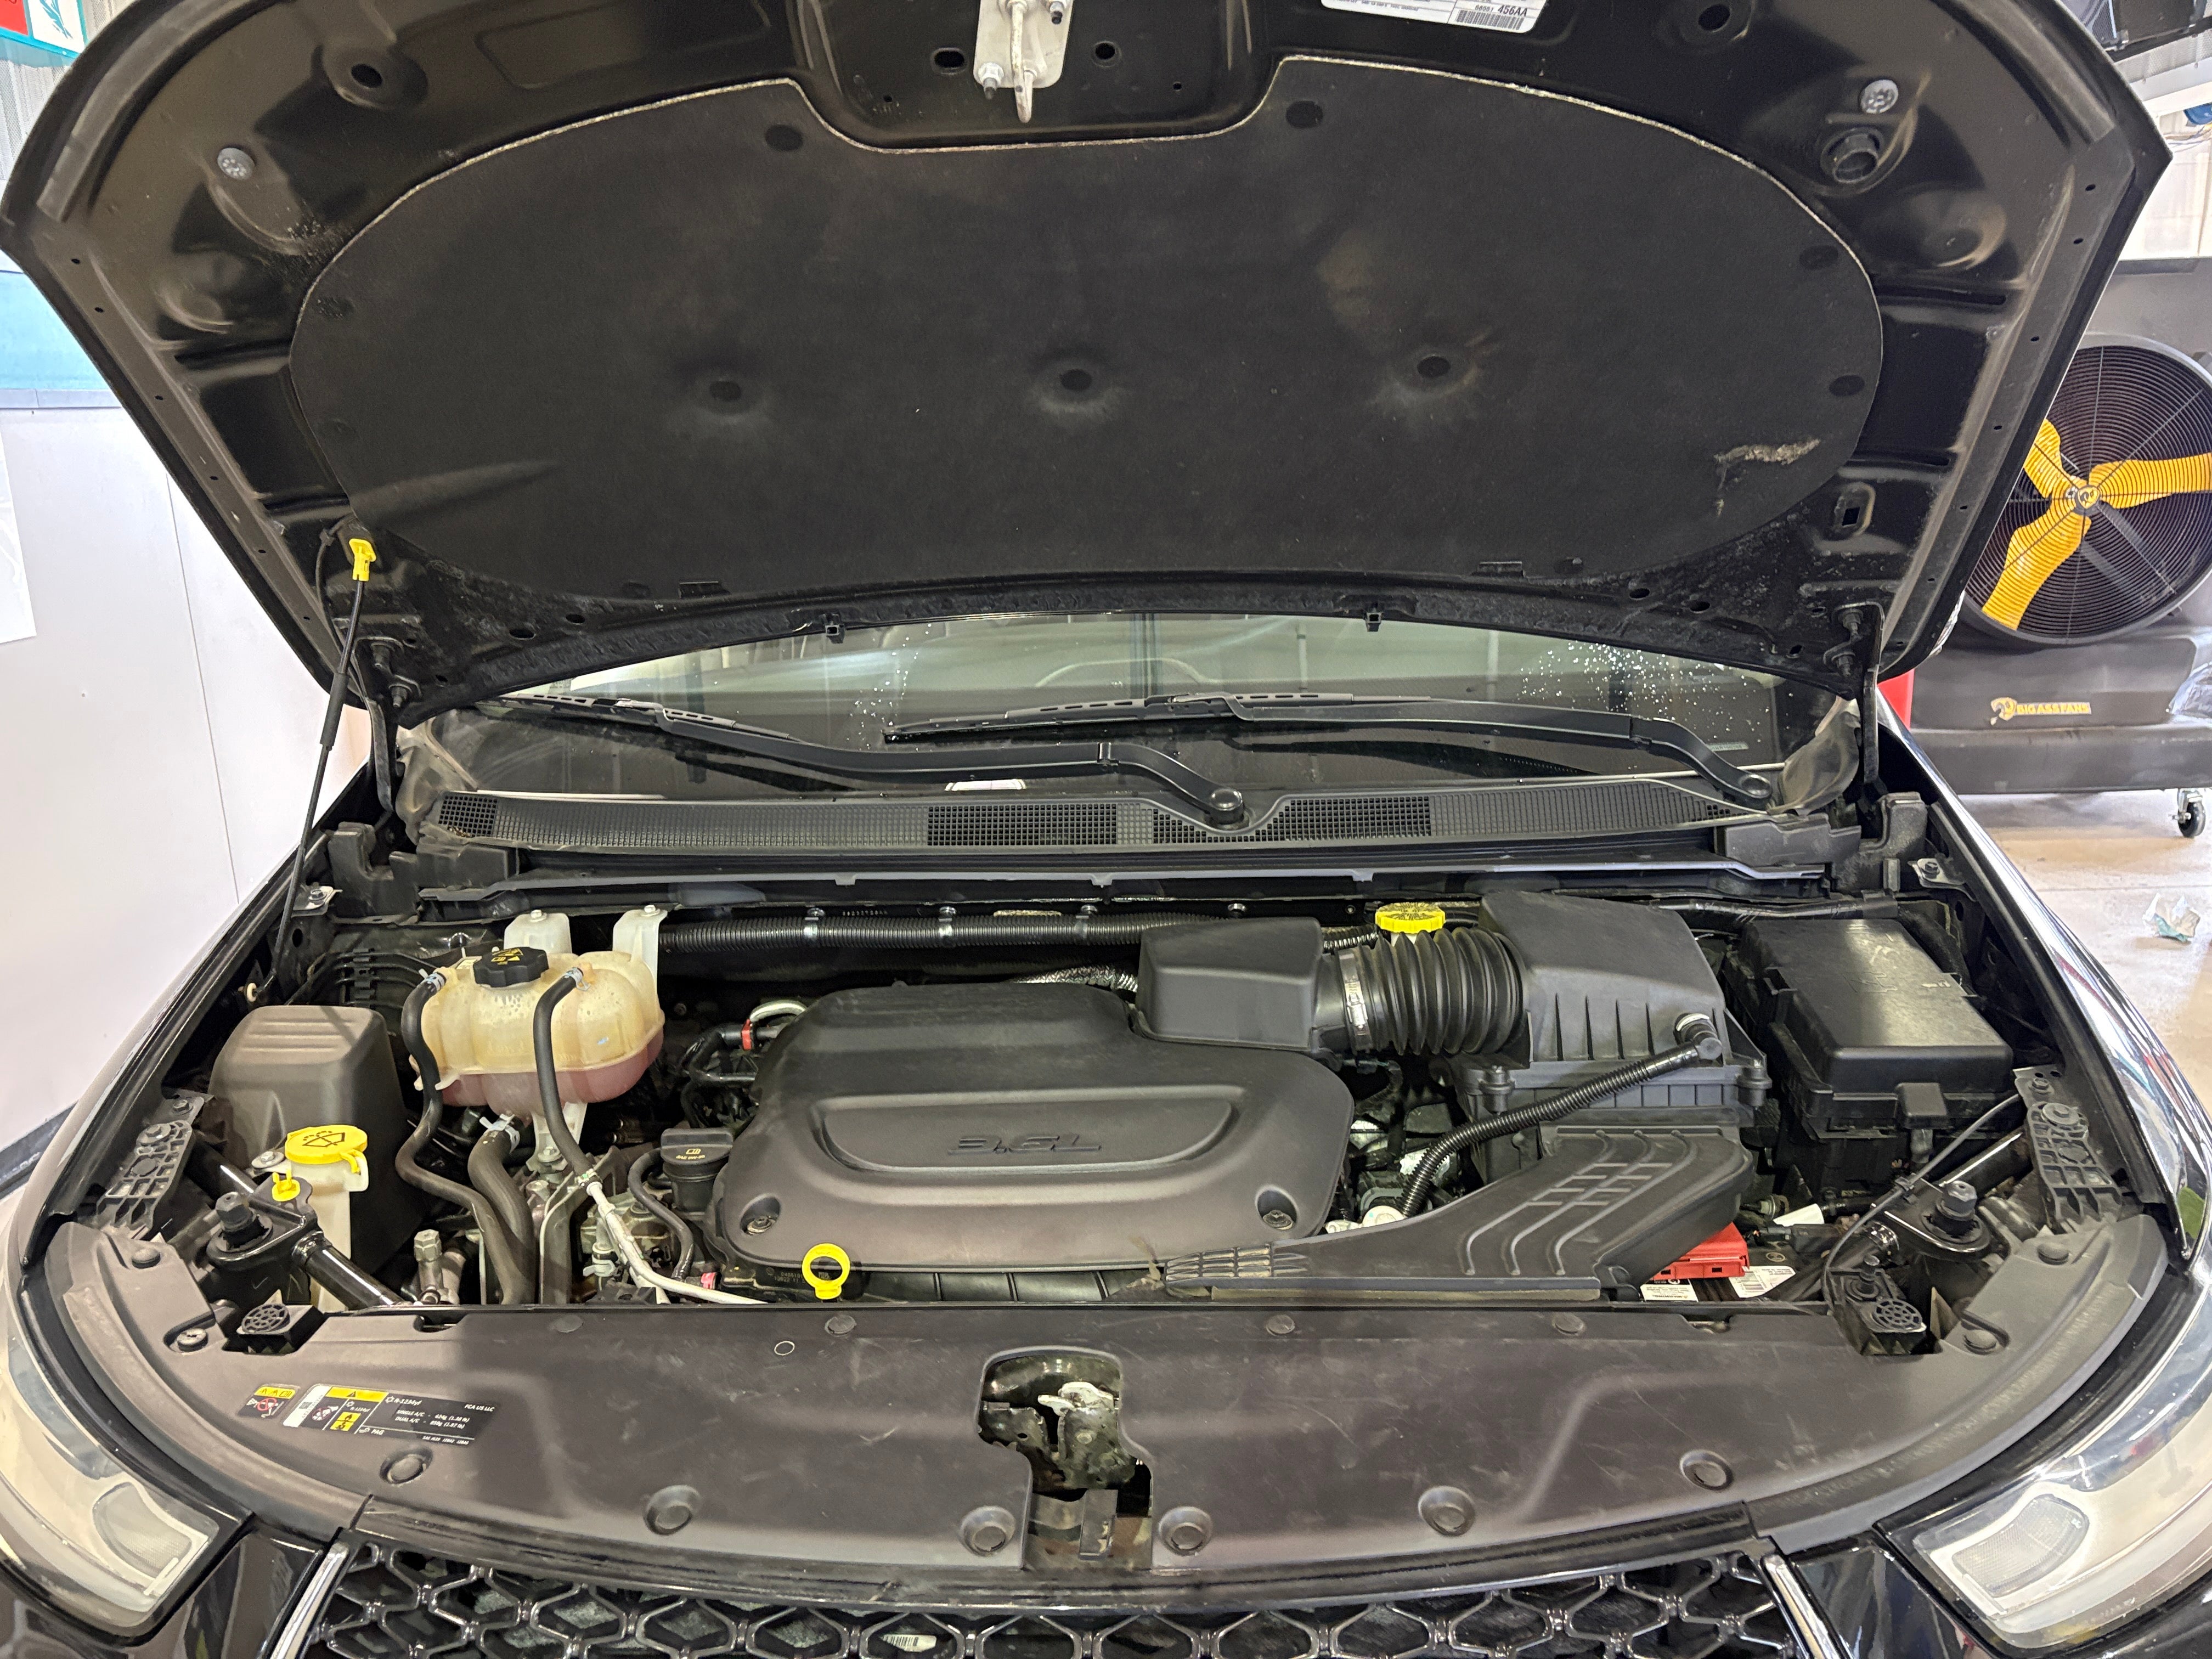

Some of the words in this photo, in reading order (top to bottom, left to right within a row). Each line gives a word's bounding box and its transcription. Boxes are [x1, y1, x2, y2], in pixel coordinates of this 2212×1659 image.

[1498, 4, 1528, 16] 456AA
[2017, 704, 2036, 714] BIG
[2037, 704, 2061, 714] ASS
[2061, 703, 2089, 713] FANS
